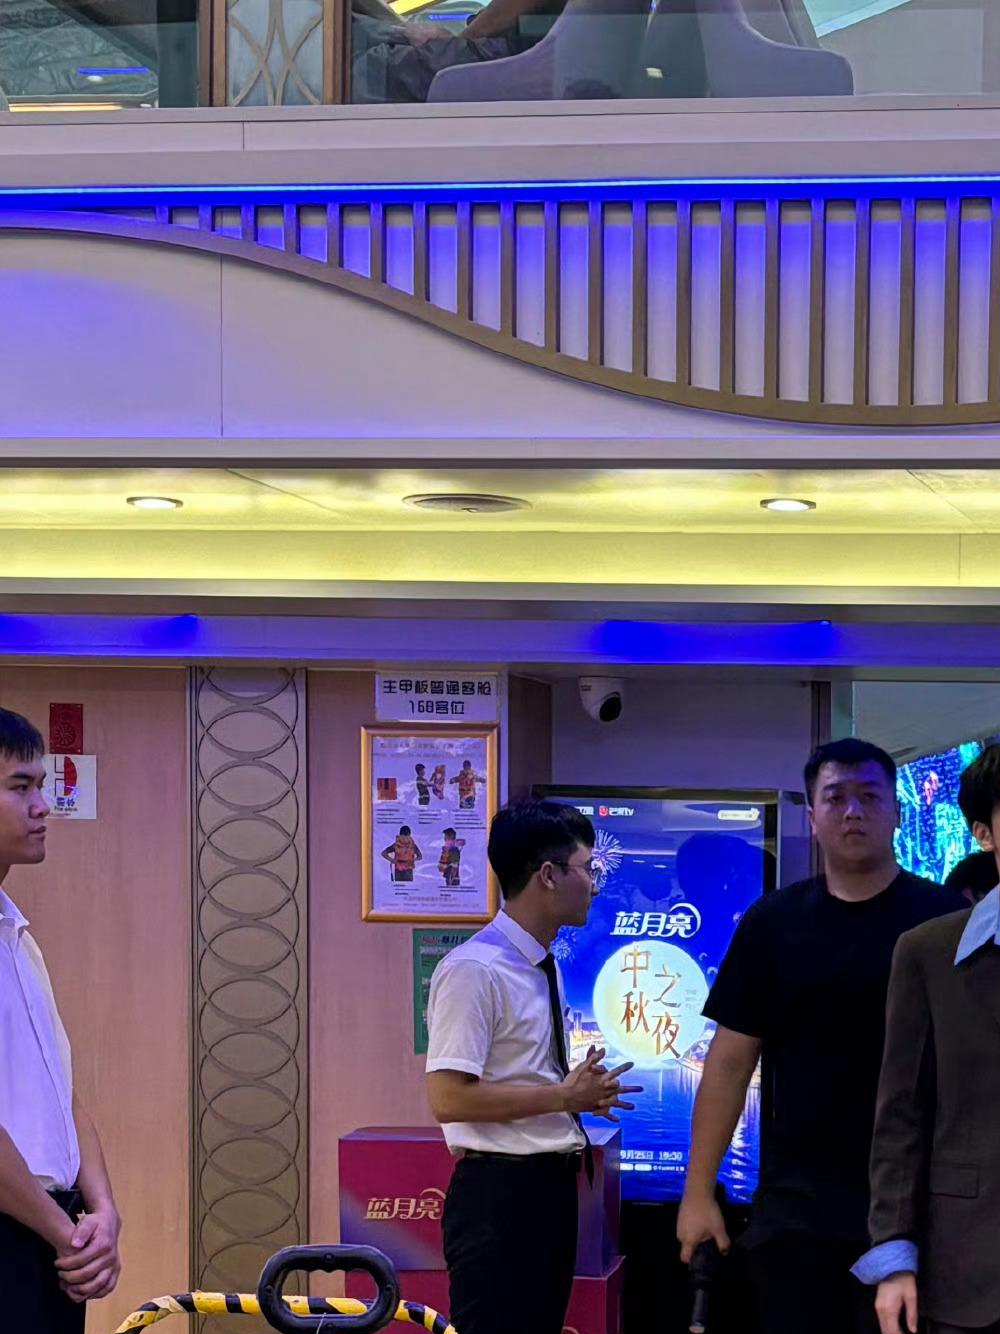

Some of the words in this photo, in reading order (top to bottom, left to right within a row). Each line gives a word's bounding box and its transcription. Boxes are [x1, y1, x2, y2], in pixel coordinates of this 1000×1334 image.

[382, 679, 492, 696] 主甲板普通客舱
[409, 700, 465, 715] 168客位
[609, 902, 702, 938] 蓝月亮
[363, 1187, 447, 1220] 蓝月亮
